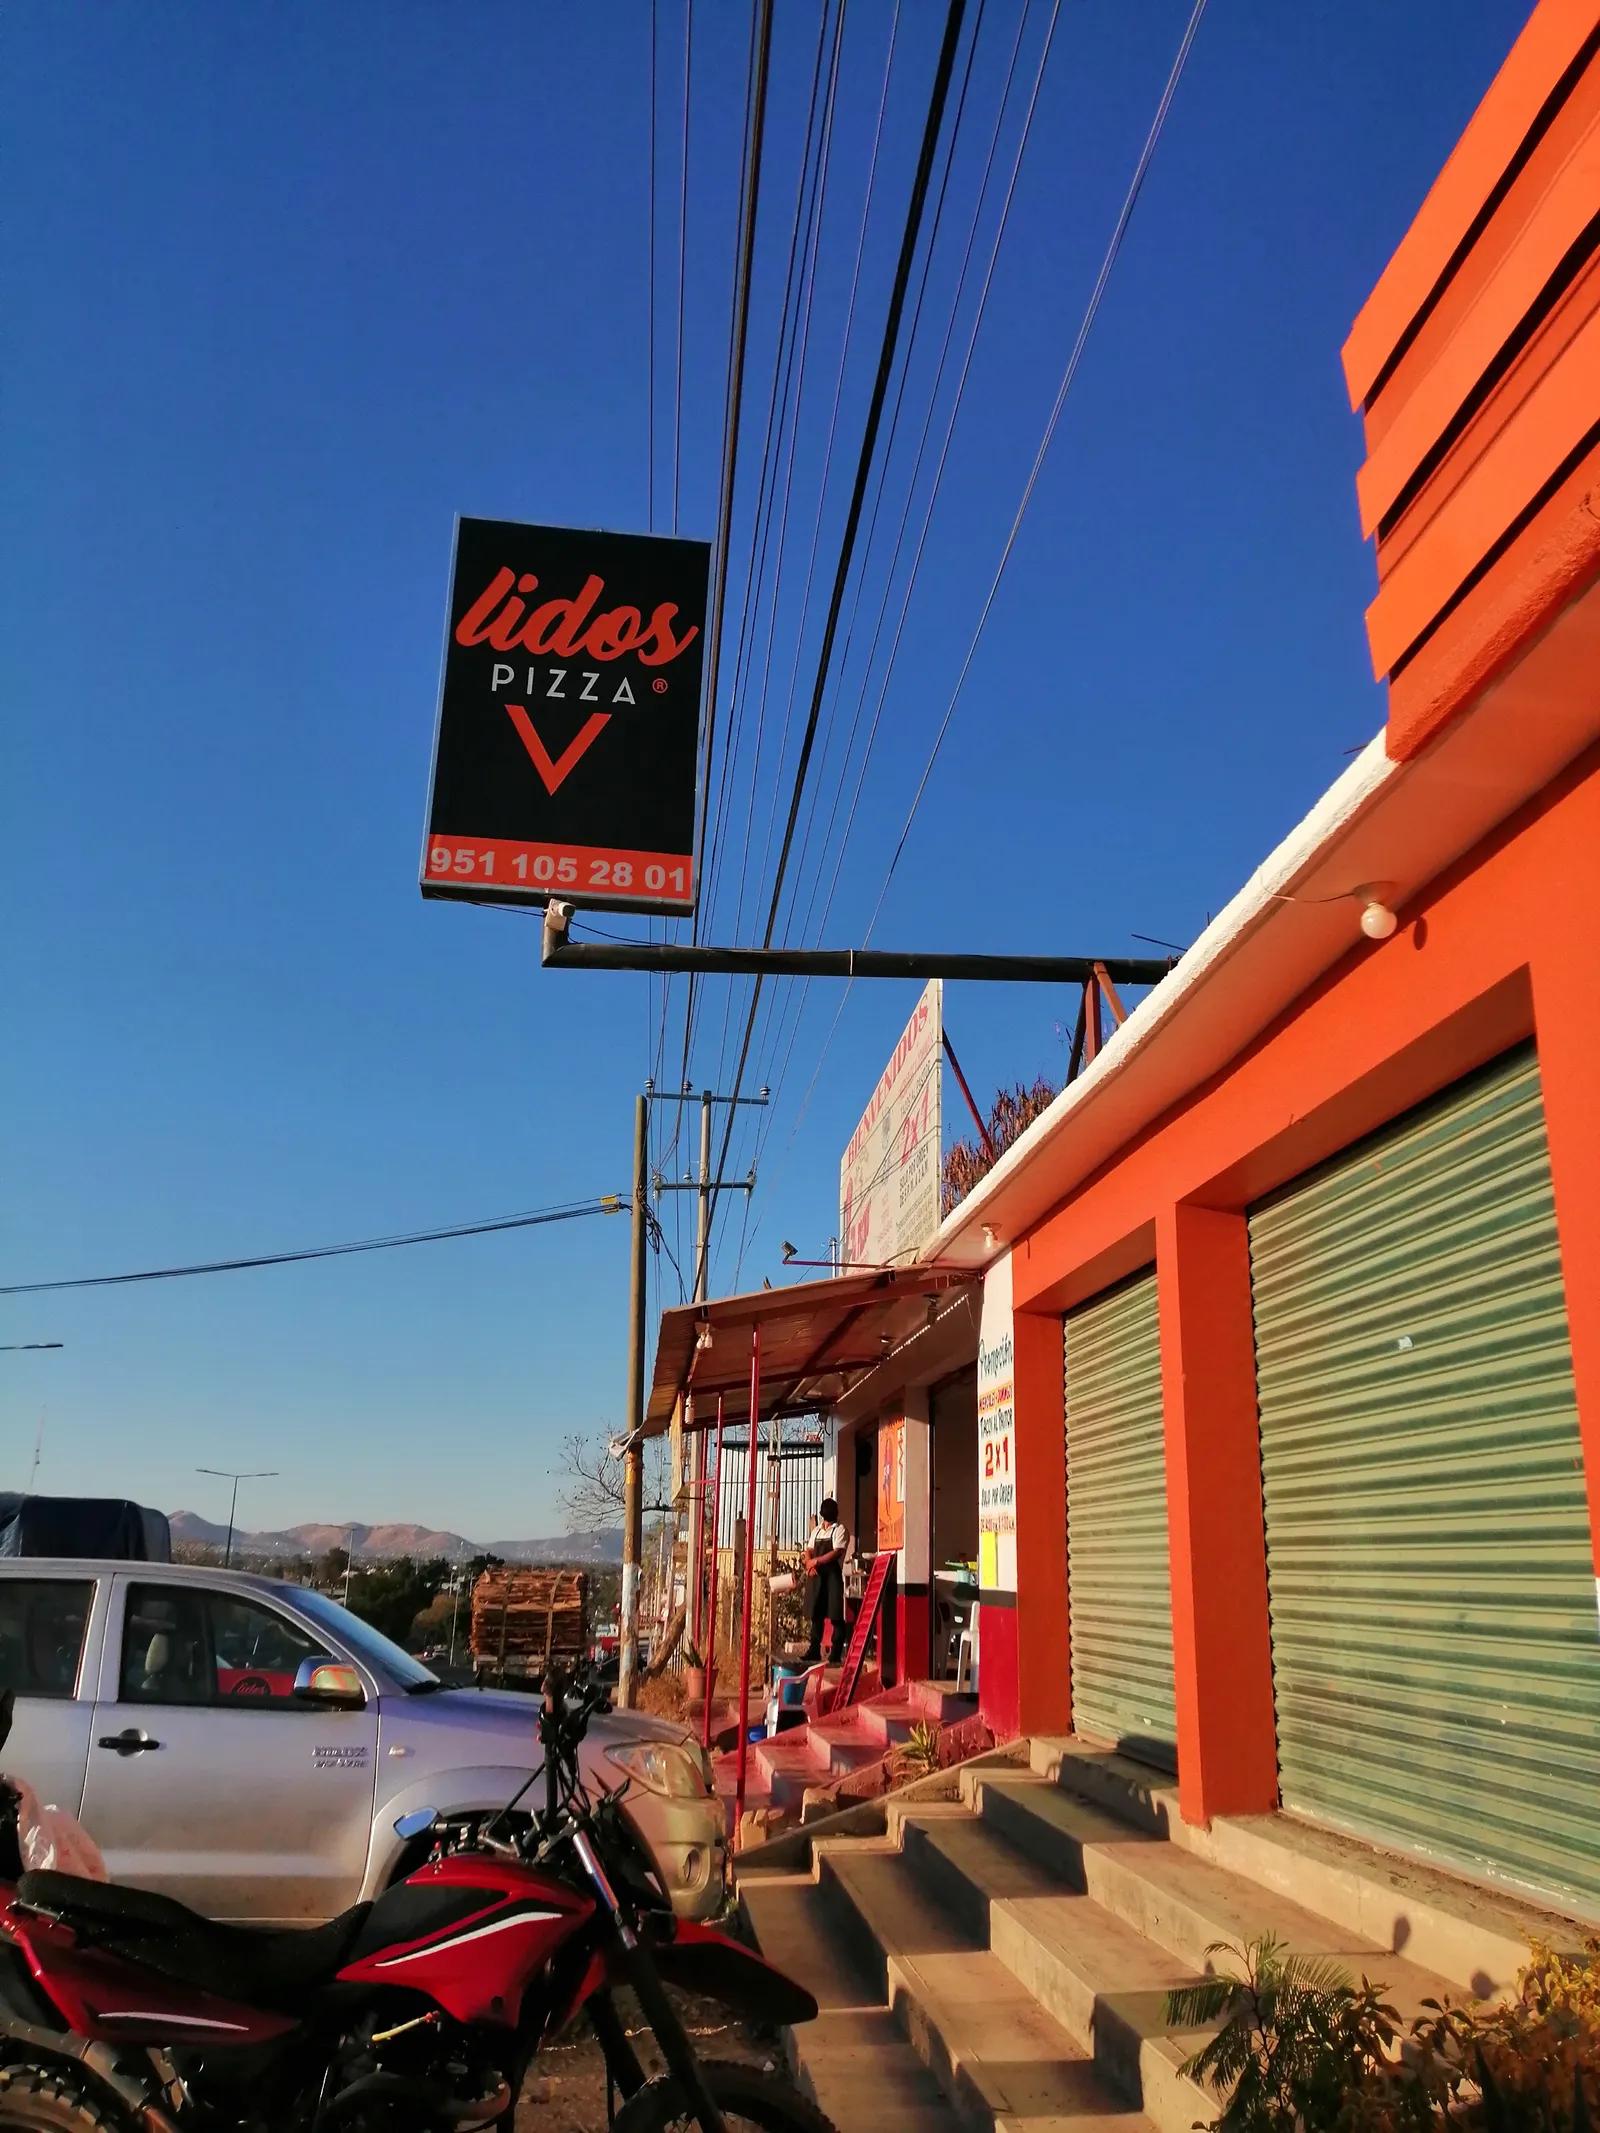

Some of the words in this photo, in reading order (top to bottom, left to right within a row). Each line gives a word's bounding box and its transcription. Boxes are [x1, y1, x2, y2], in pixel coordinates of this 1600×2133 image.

[455, 566, 699, 666] lidos
[491, 663, 636, 705] PIZZA
[430, 847, 495, 876] 951
[511, 853, 577, 882] 105
[588, 861, 633, 887] 28
[645, 867, 685, 892] 01
[848, 993, 928, 1168] BIENVENIDOS
